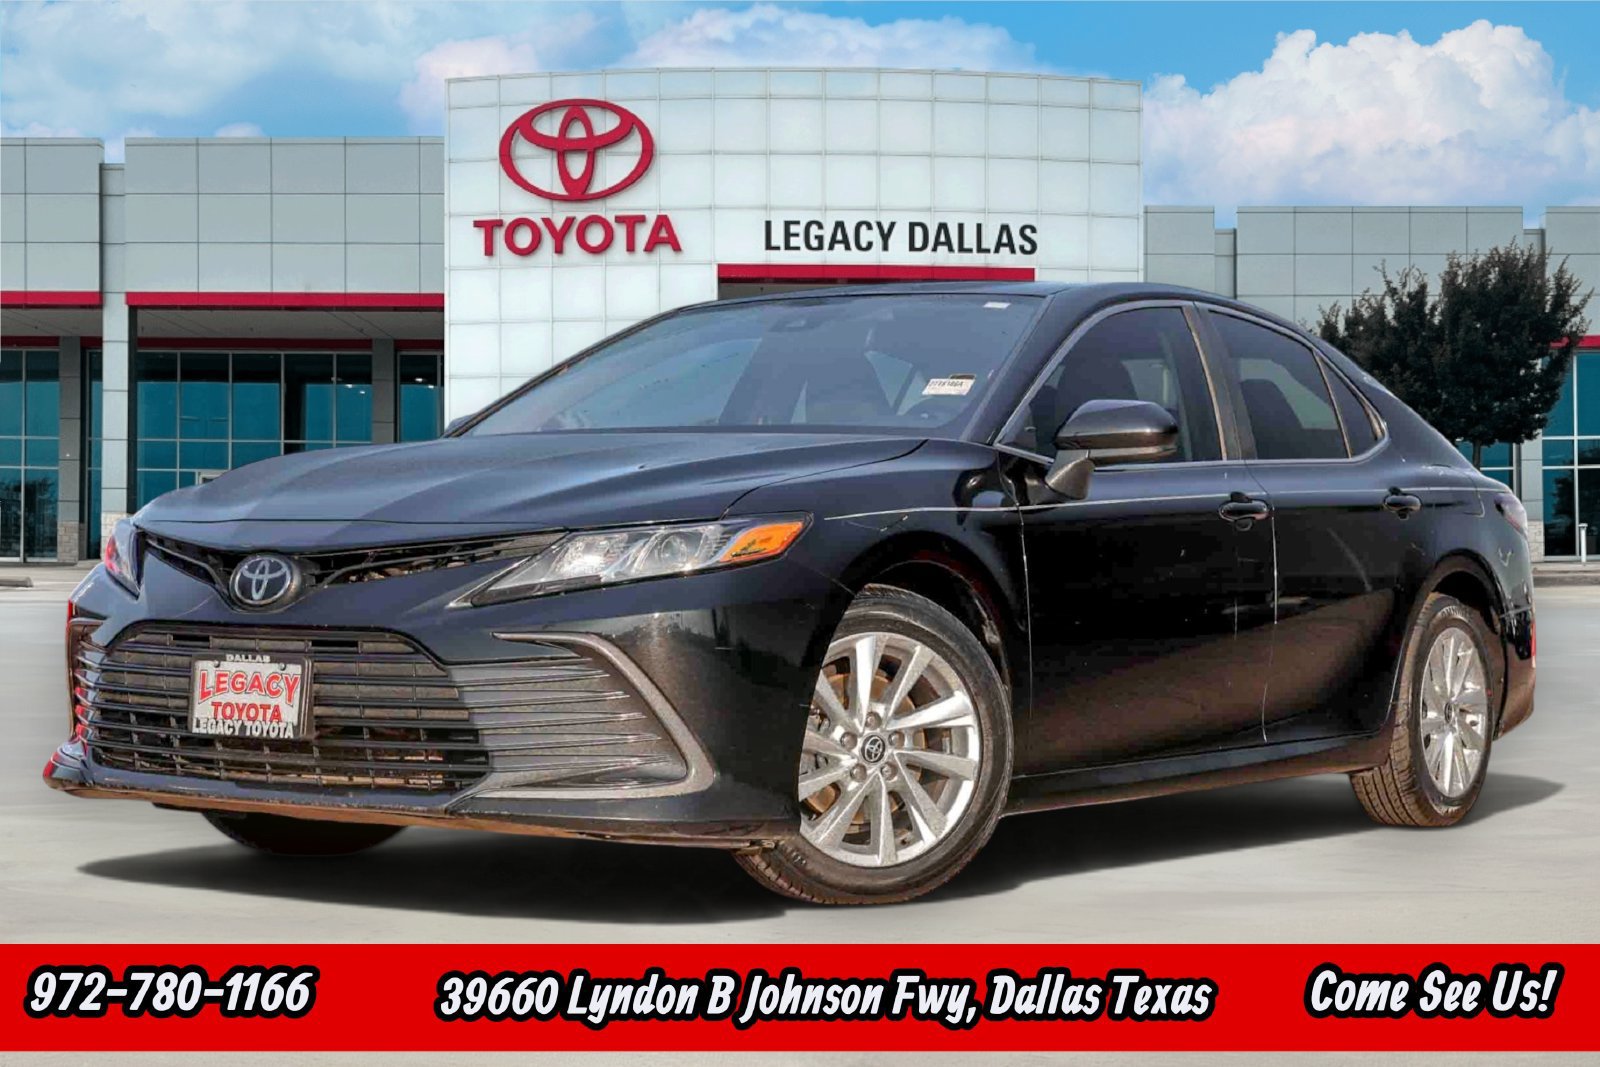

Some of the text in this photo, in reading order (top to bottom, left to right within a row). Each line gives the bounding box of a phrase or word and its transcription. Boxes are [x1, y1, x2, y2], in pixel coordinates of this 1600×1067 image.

[473, 213, 682, 257] TOYOTA
[764, 220, 1038, 255] LEGACY DALLAS
[225, 653, 271, 663] DALLAS
[198, 669, 301, 707] LEGACY
[211, 701, 283, 723] TOYOTA
[192, 717, 294, 739] LEGACY TOYOTA
